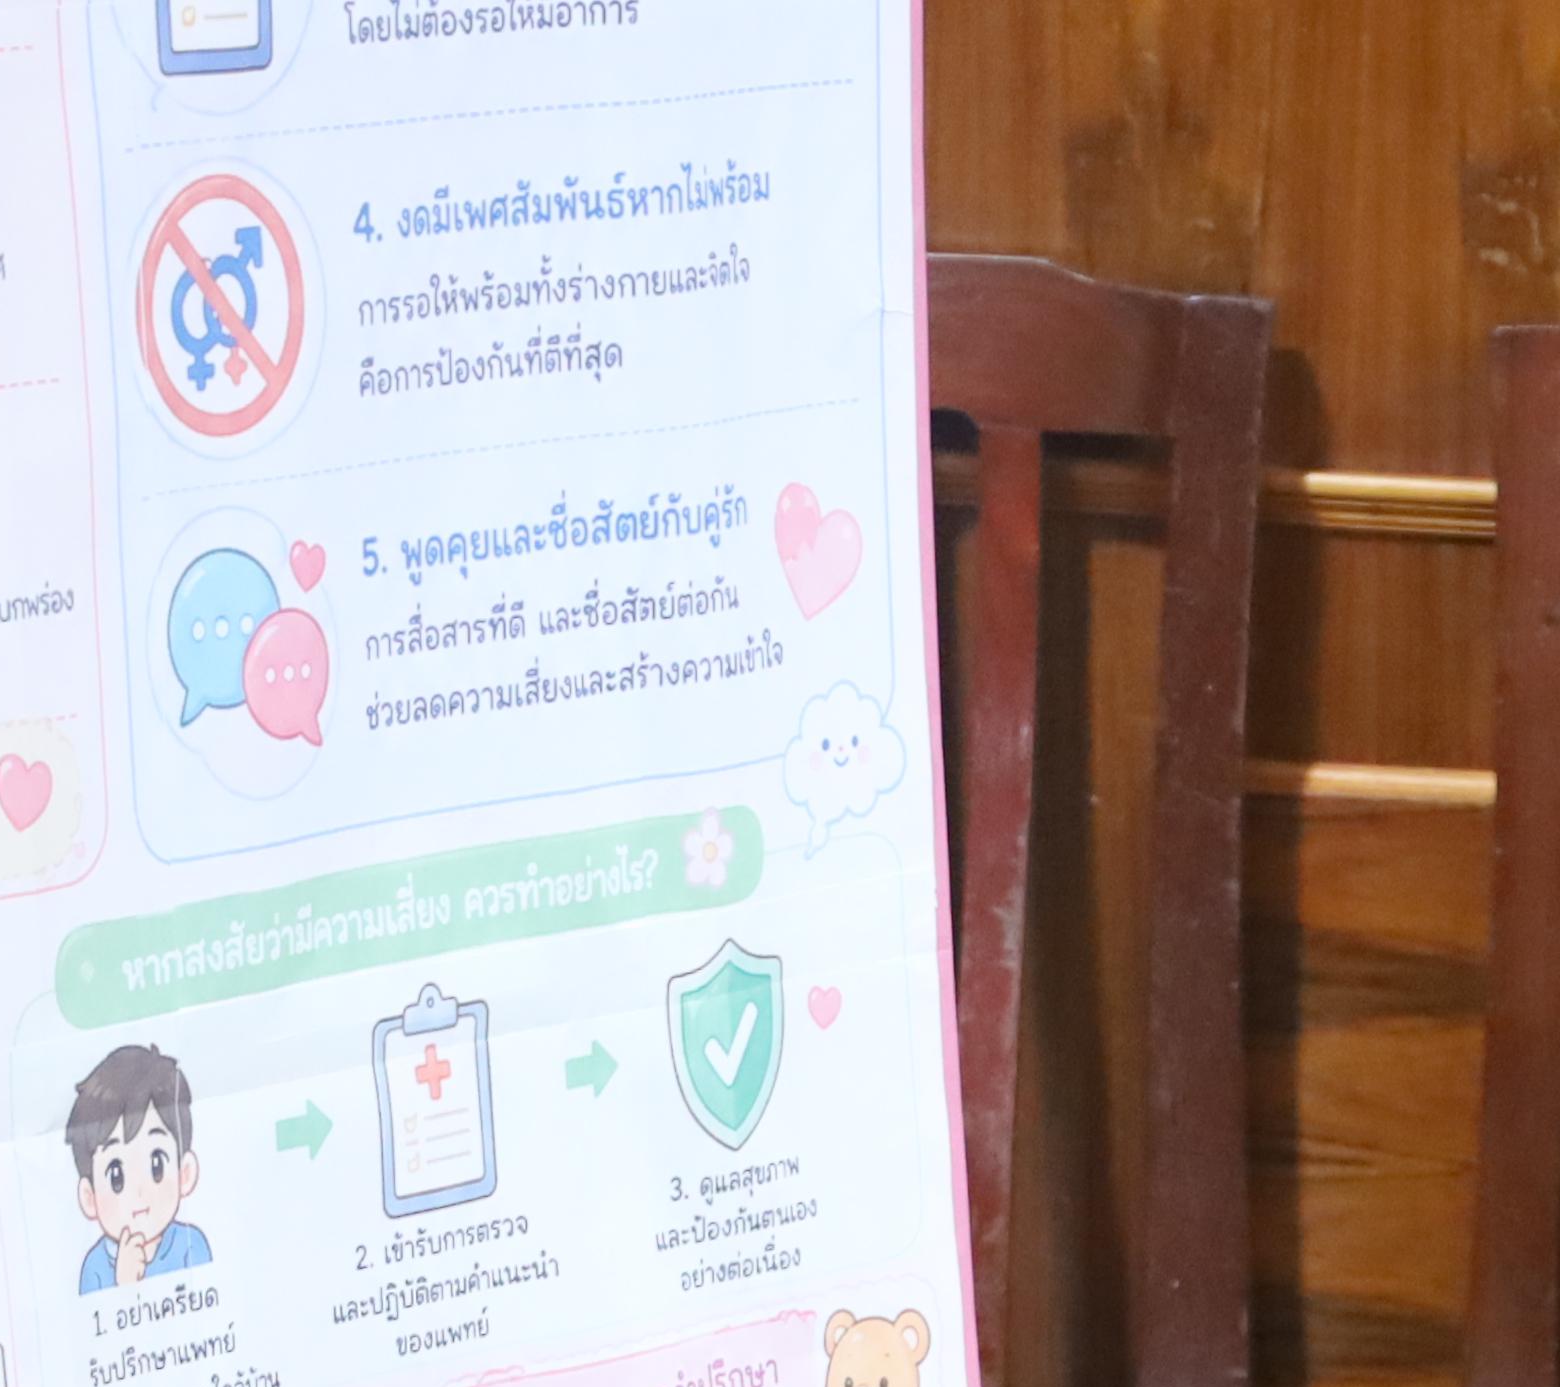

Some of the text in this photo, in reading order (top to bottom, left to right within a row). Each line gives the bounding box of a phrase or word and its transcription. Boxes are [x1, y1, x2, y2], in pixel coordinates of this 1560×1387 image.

[699, 1152, 801, 1206] ดูแลสุขภาพ
[395, 1307, 492, 1357] ของแพทย์
